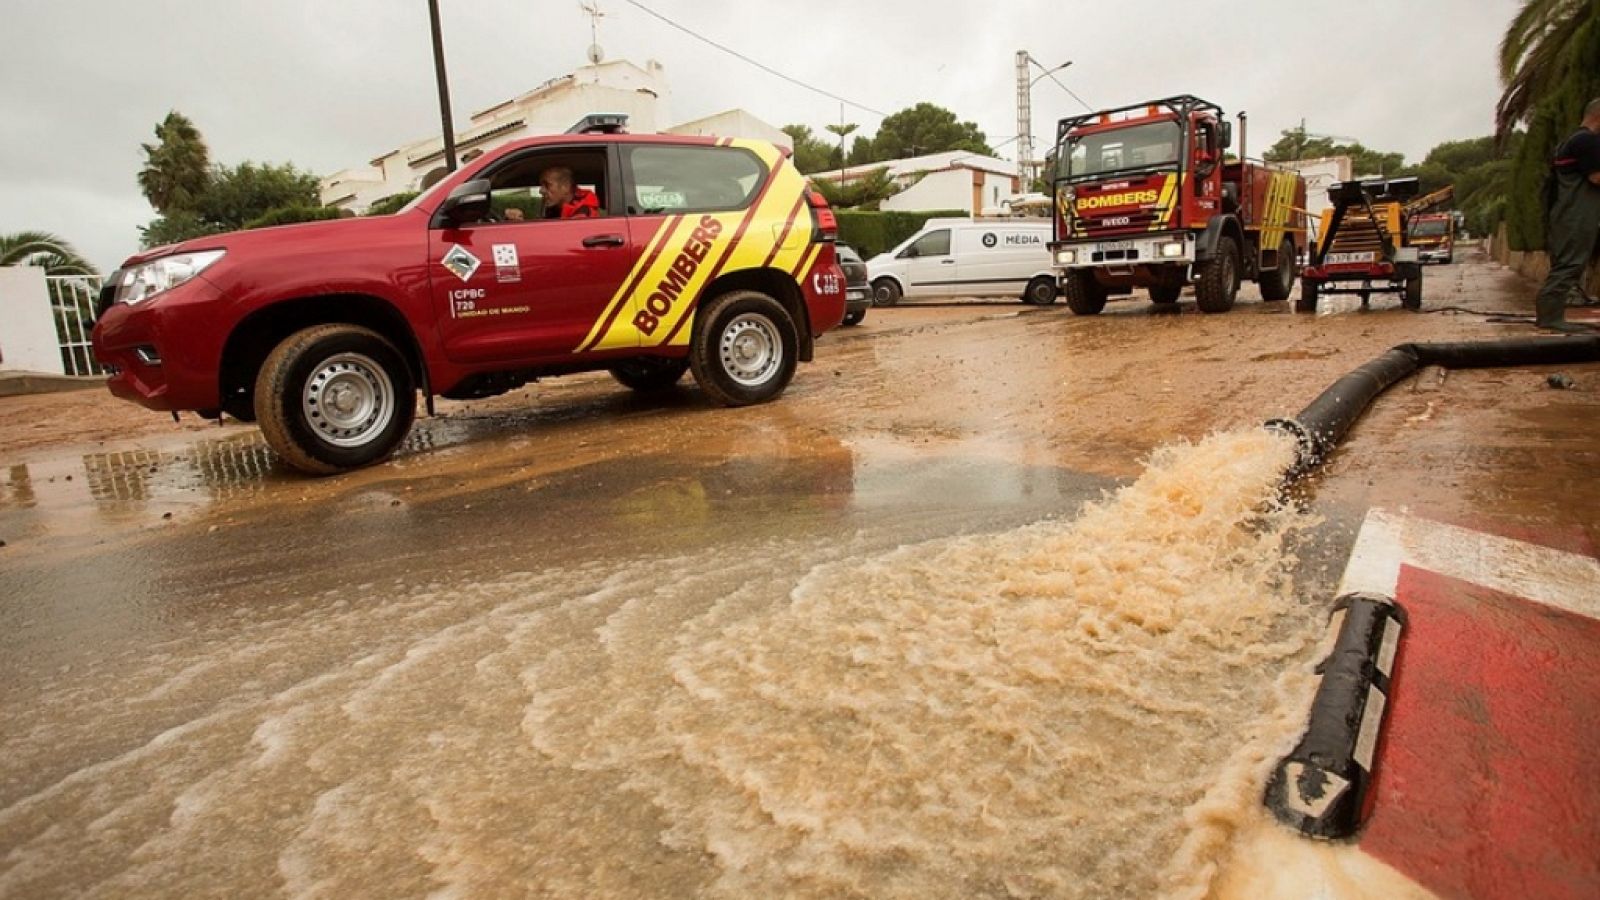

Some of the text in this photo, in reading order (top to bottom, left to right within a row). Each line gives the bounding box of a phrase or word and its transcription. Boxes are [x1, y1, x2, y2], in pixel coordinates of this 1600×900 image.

[1077, 190, 1158, 209] BOMBERS
[1102, 216, 1130, 227] IVECO
[632, 214, 723, 337] BOMBERS
[454, 288, 486, 300] CPBC
